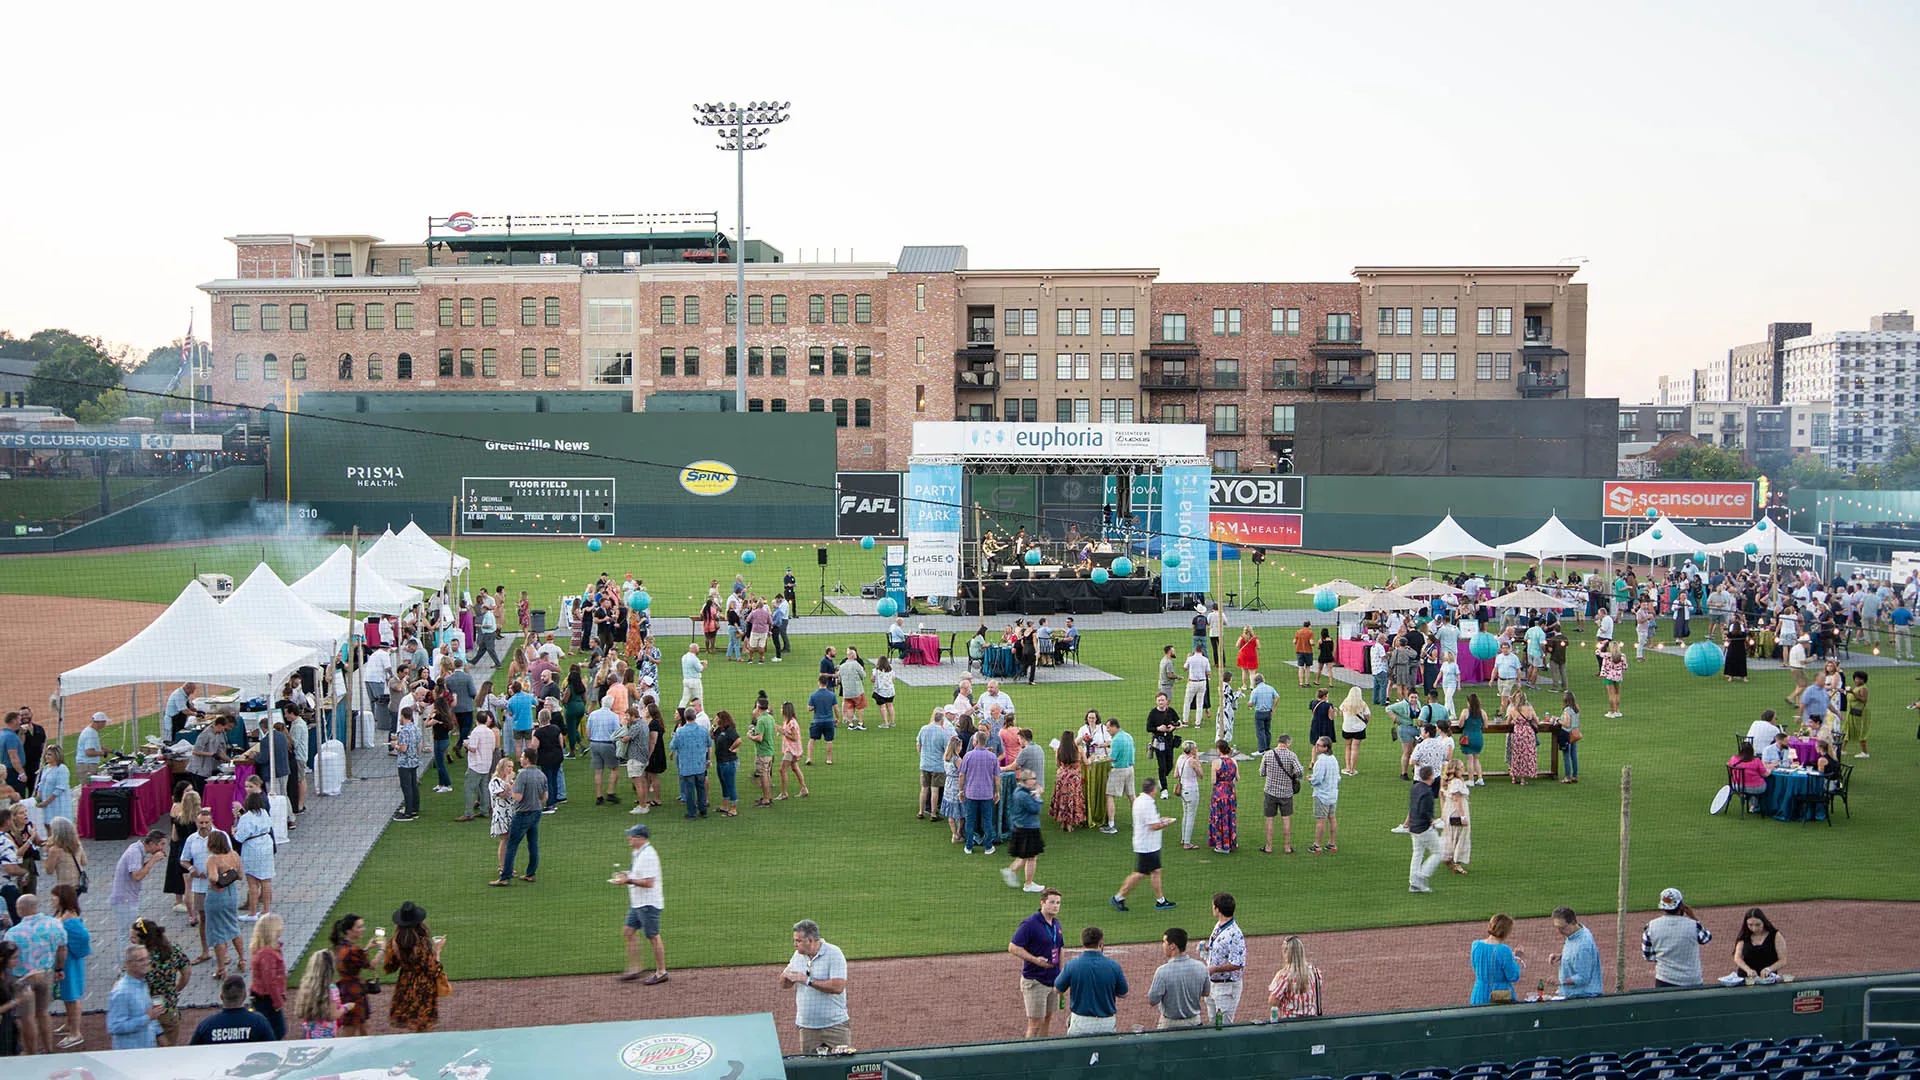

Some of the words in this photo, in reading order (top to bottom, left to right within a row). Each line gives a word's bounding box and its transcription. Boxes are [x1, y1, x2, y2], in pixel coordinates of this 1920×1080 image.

[29, 434, 130, 446] CLUBHOUSE
[1016, 425, 1104, 451] euphoria
[485, 439, 551, 451] Greenville
[554, 439, 590, 451] News
[347, 467, 404, 479] PRISMA
[915, 485, 956, 497] PARTY
[1208, 480, 1283, 504] RYOBI
[1639, 491, 1745, 507] scansource
[856, 498, 896, 513] AFL
[299, 508, 318, 519] 310
[919, 510, 951, 521] PARK
[1174, 500, 1195, 583] euphoria
[912, 555, 944, 563] CHASE
[211, 1026, 252, 1041] SECURITY
[852, 1064, 881, 1073] CAUTION
